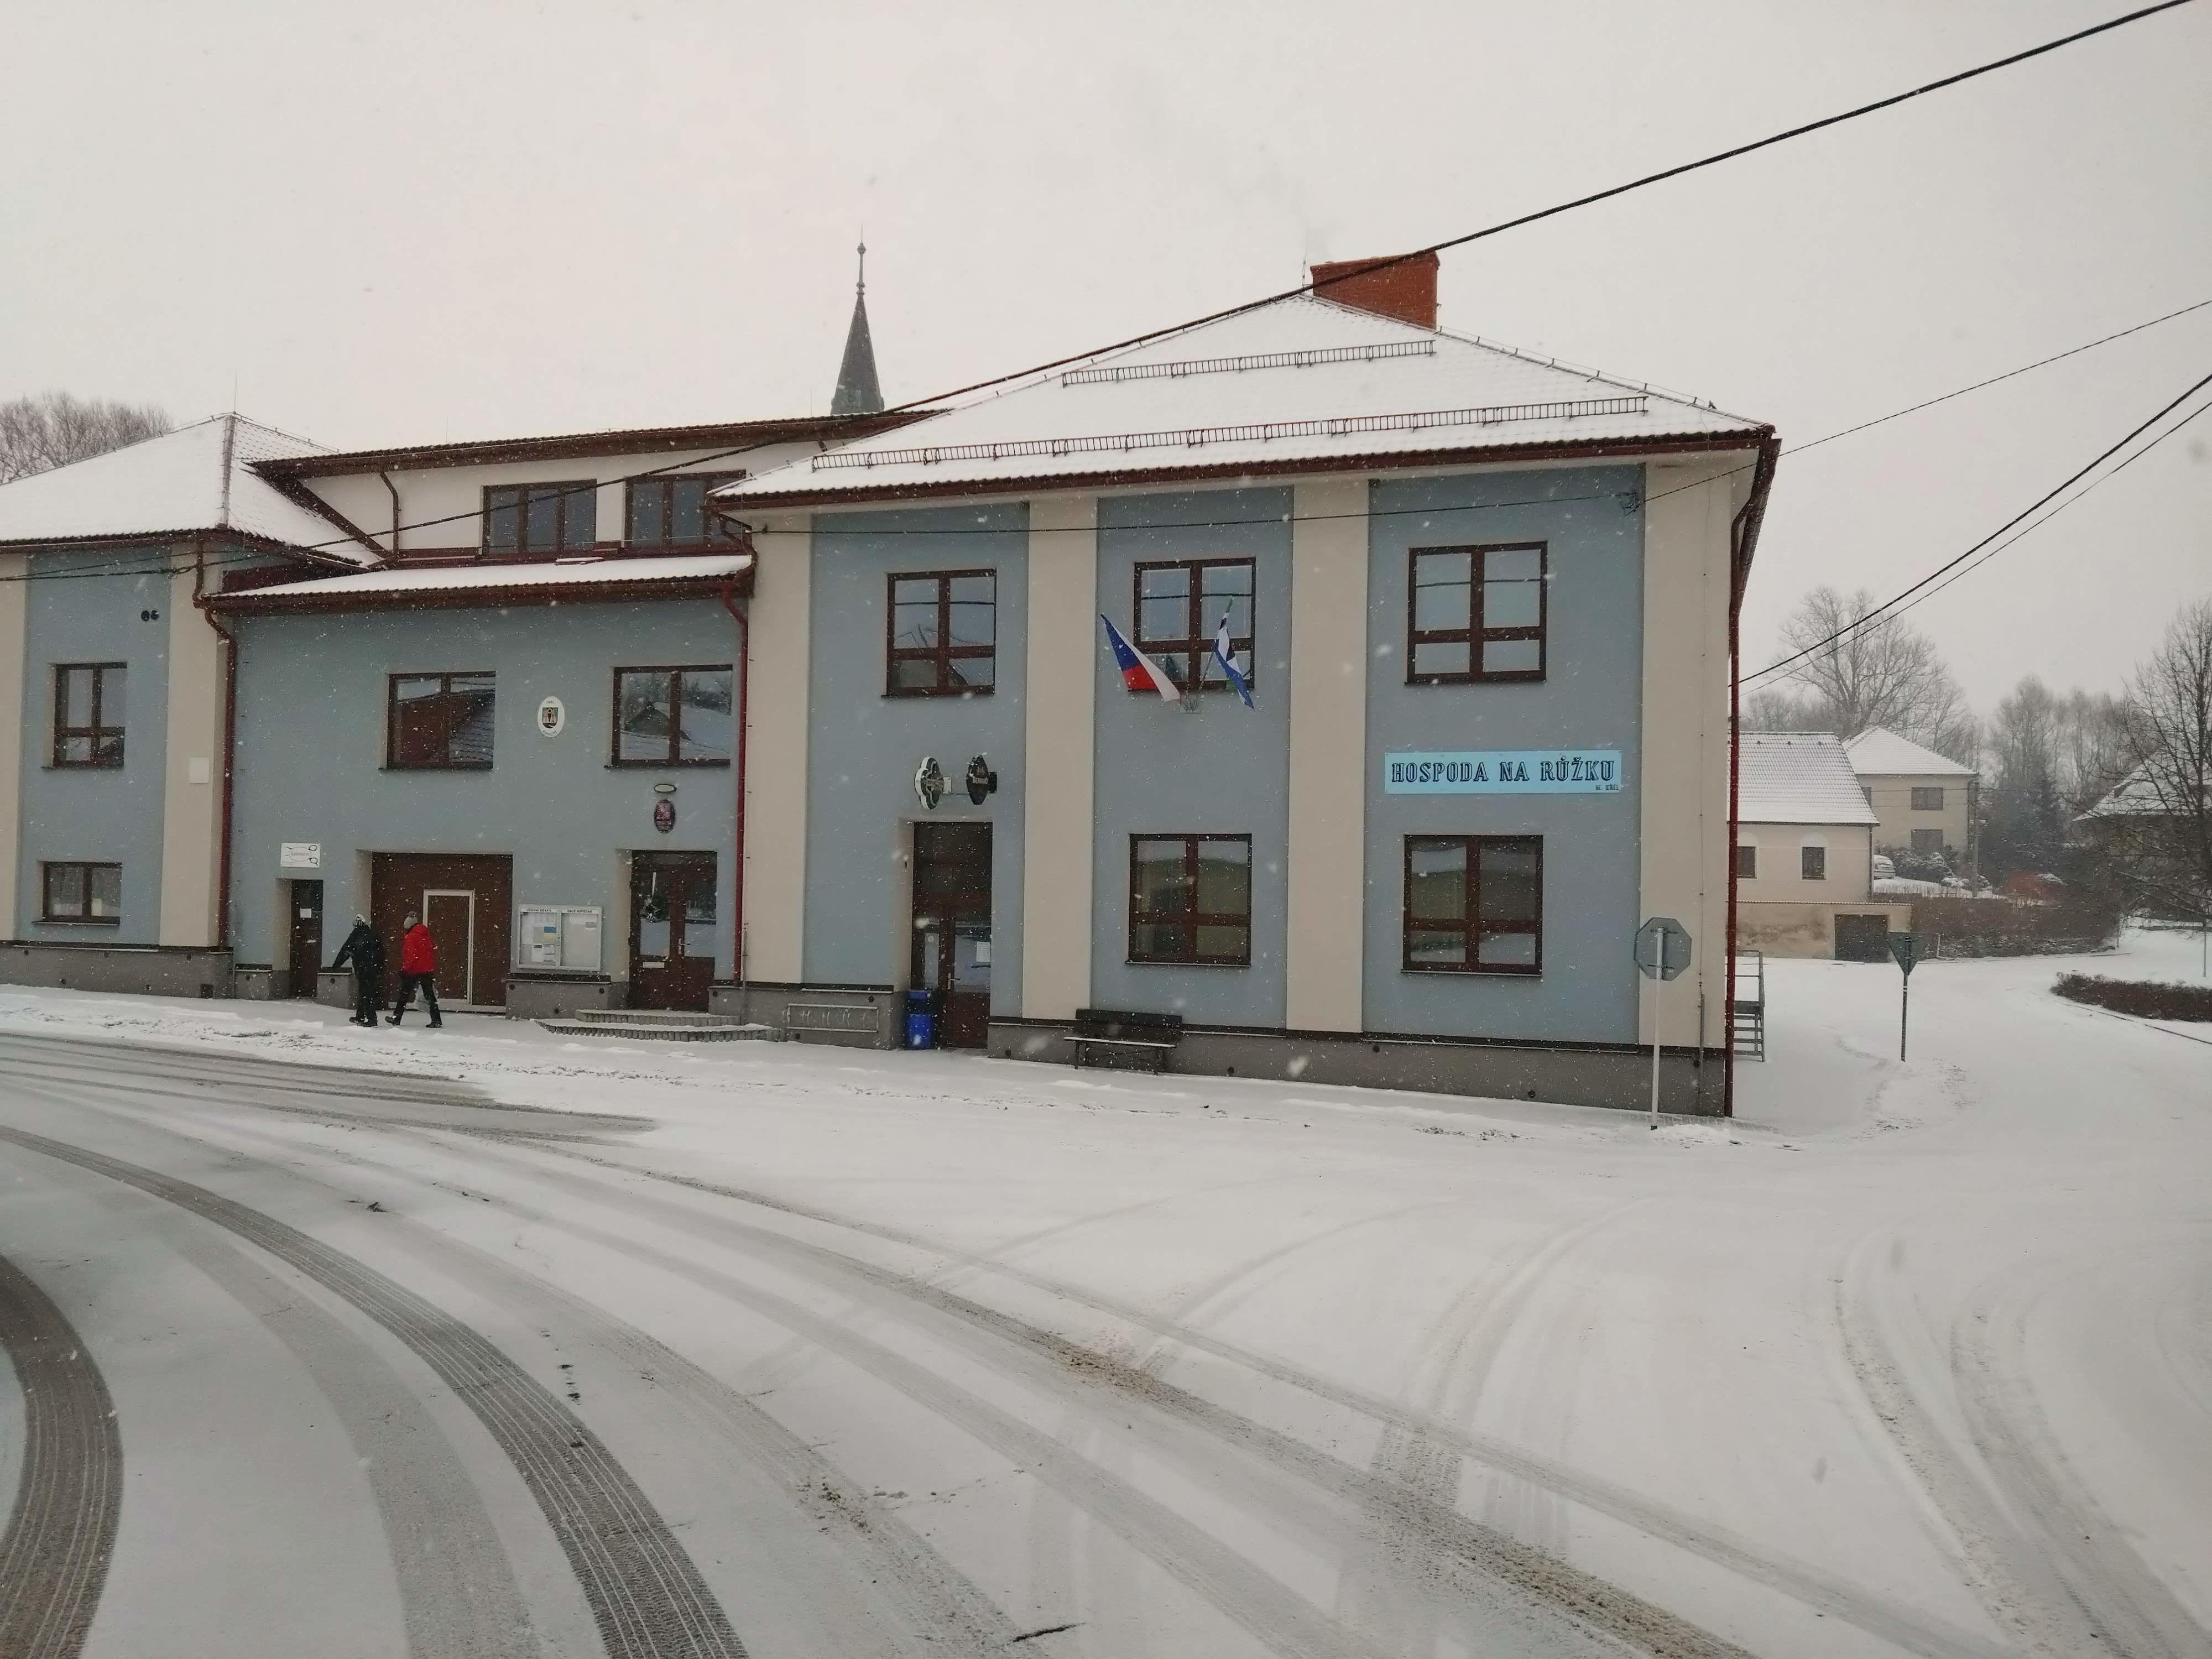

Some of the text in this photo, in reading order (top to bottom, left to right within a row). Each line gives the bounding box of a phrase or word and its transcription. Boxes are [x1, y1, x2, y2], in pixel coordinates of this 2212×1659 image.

[1391, 755, 1615, 783] HOSPODA NA RŮŽKU
